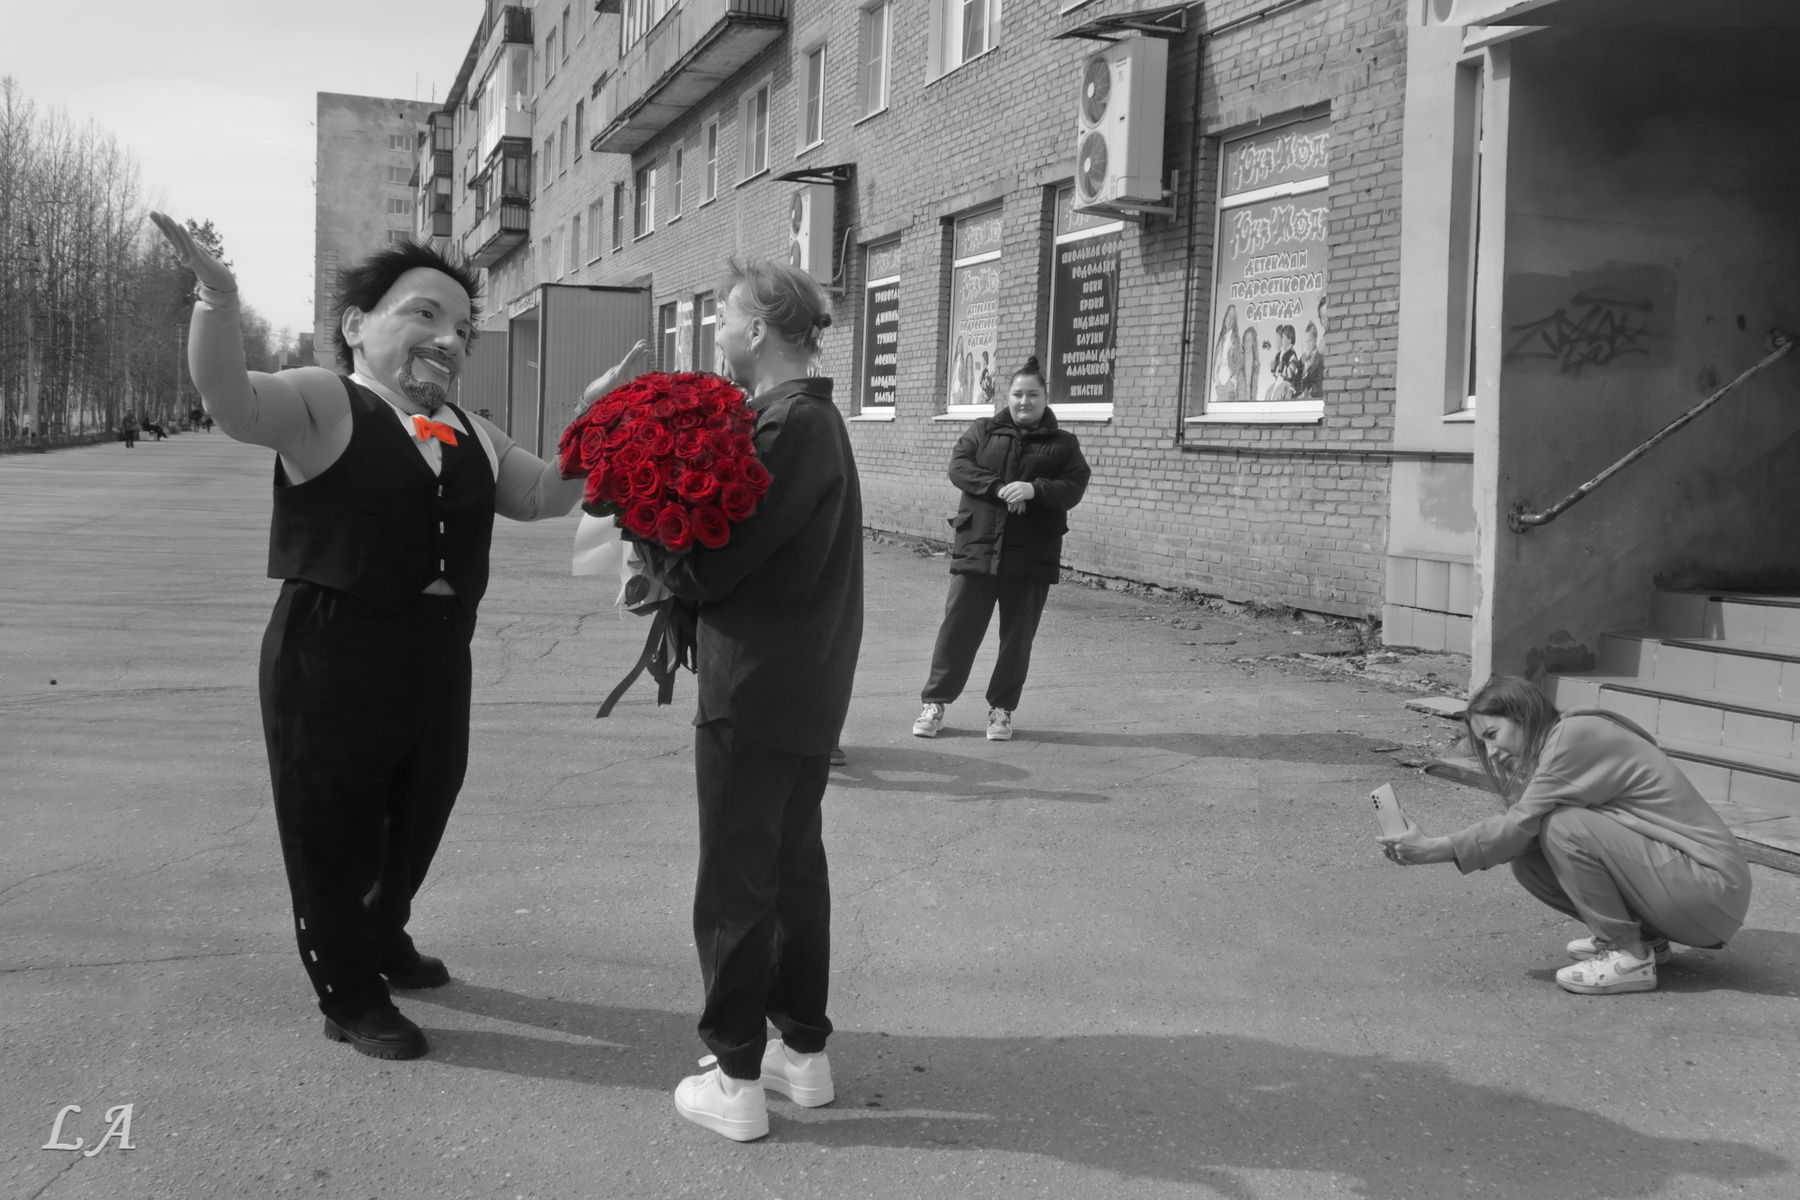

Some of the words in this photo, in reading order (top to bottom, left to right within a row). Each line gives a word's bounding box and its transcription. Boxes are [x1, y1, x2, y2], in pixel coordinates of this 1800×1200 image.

[1062, 245, 1100, 264] ШКОЛЬНАЯ
[1072, 258, 1116, 279] ВОДОЛАЗКИ
[1244, 250, 1298, 277] ДЕТСКАЯ
[1299, 248, 1308, 270] И
[1082, 278, 1103, 293] ЮБКИ
[1230, 272, 1323, 300] ПОДРОСТКОВАЯ
[1080, 296, 1104, 311] БРЮКИ
[1245, 298, 1303, 322] ОДЕЖДА
[1073, 313, 1109, 330] ПИДЖАКИ
[1076, 331, 1104, 346] БЛУЗКИ
[1062, 349, 1098, 364] КОСТЮМЫ
[1066, 362, 1110, 377] МАЛЬЧИКОВ
[874, 391, 895, 403] ПЛАТЬЯ
[1070, 384, 1103, 397] ЖИЛЕТКИ
